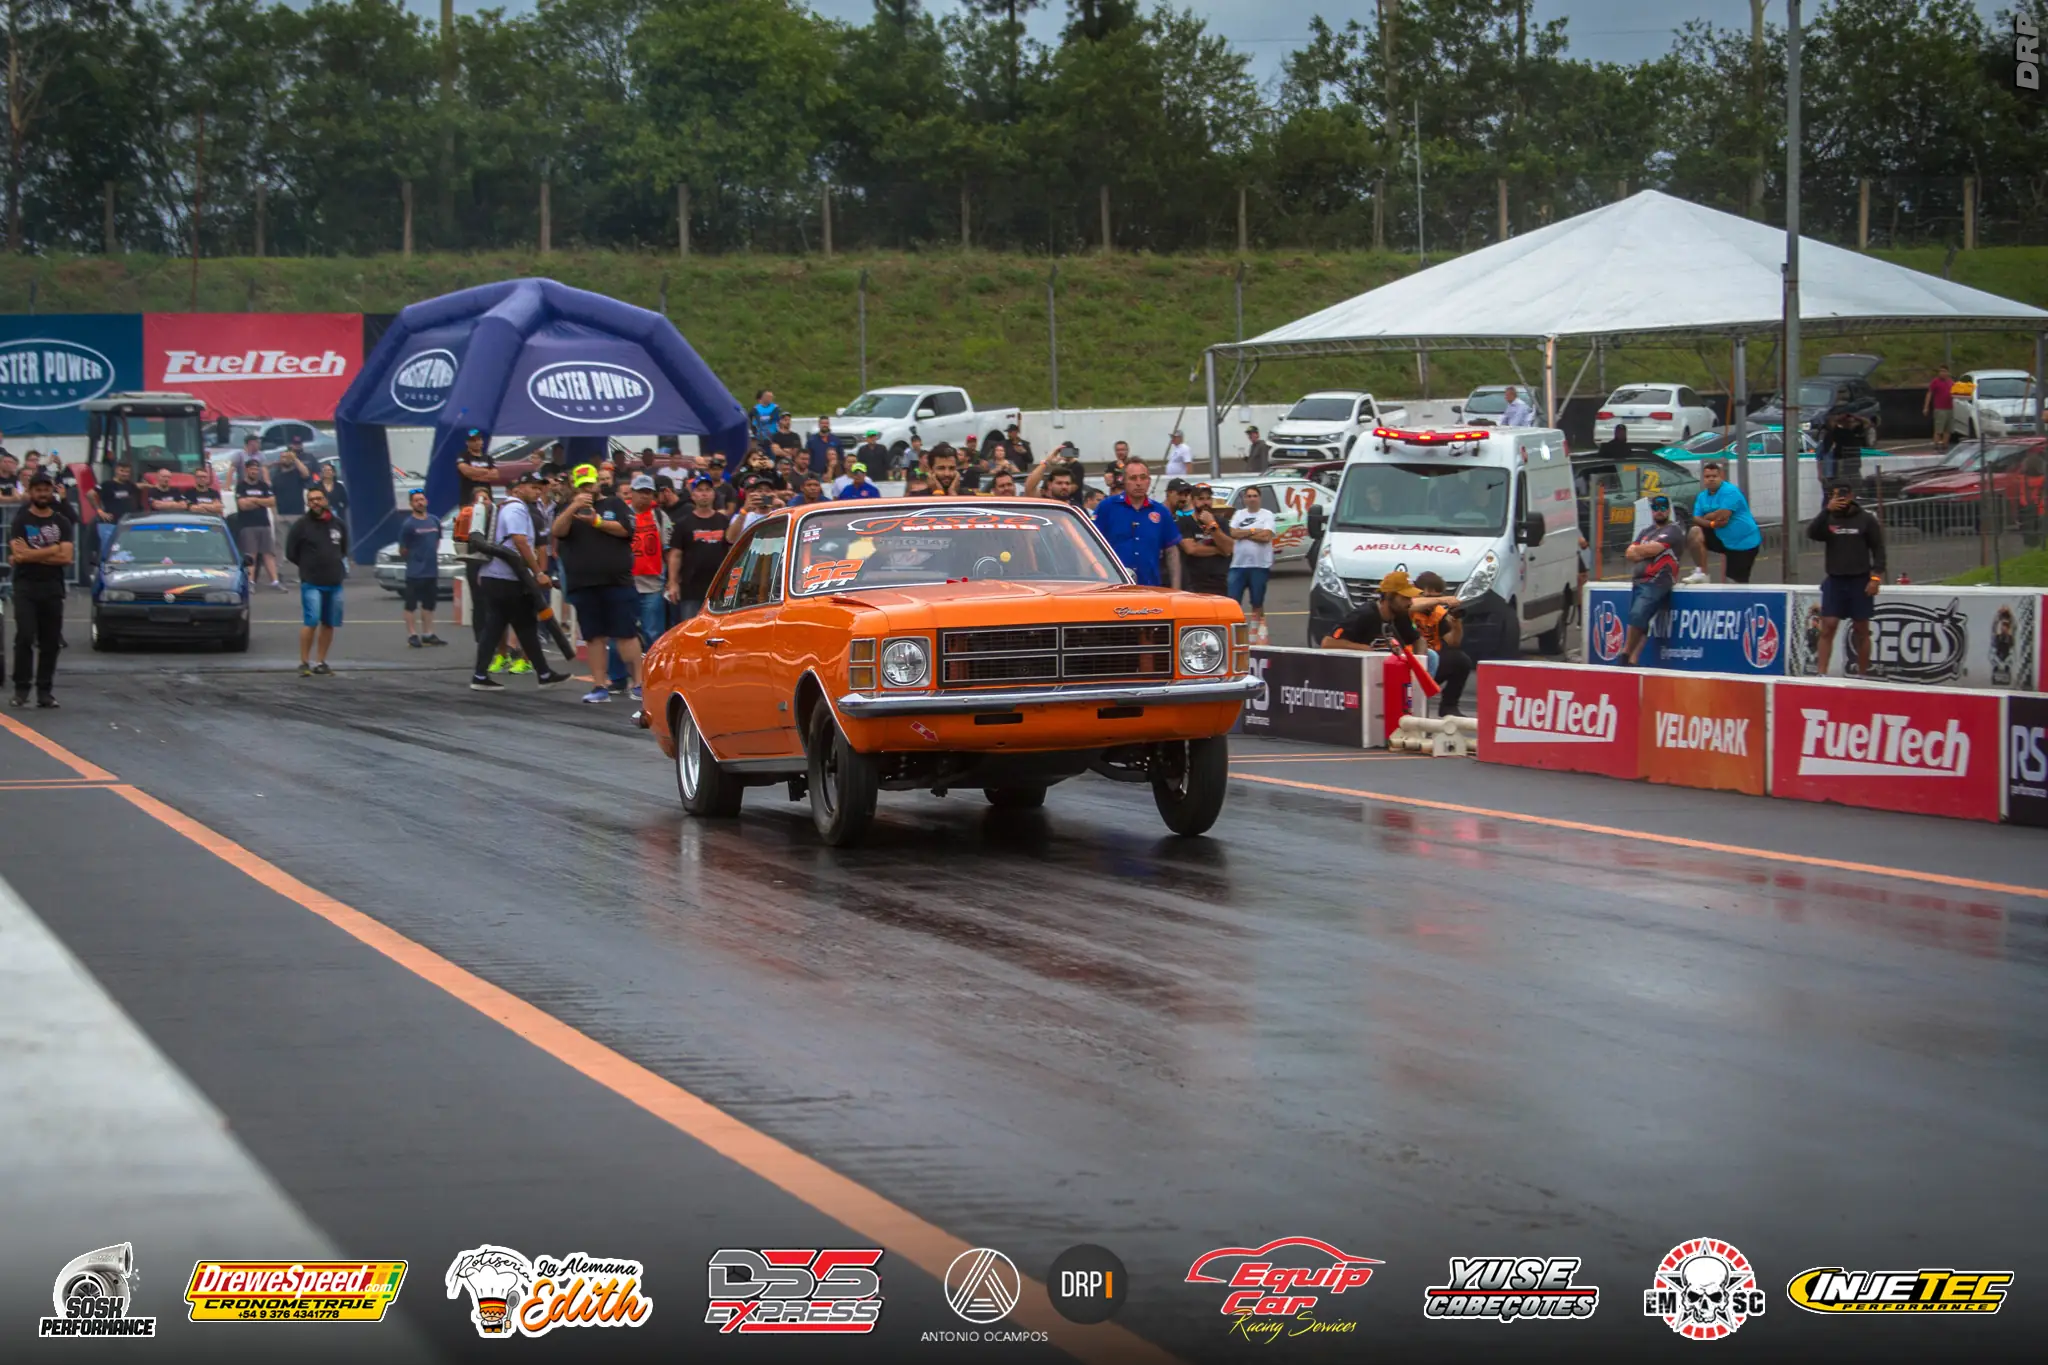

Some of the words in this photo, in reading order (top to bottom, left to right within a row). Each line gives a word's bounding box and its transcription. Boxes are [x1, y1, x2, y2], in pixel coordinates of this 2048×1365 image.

[43, 351, 103, 383] POWER
[163, 350, 347, 378] FuelTech
[537, 371, 591, 400] MASTER
[590, 371, 643, 400] POWER
[562, 404, 626, 412] TURBO
[1353, 542, 1461, 556] AMBULÂNCIA
[1679, 609, 1742, 641] POWER!
[1495, 685, 1618, 742] FuelTech
[1655, 711, 1749, 757] VELOPARK
[1799, 708, 1971, 777] FuelTech
[2011, 724, 2047, 782] RS
